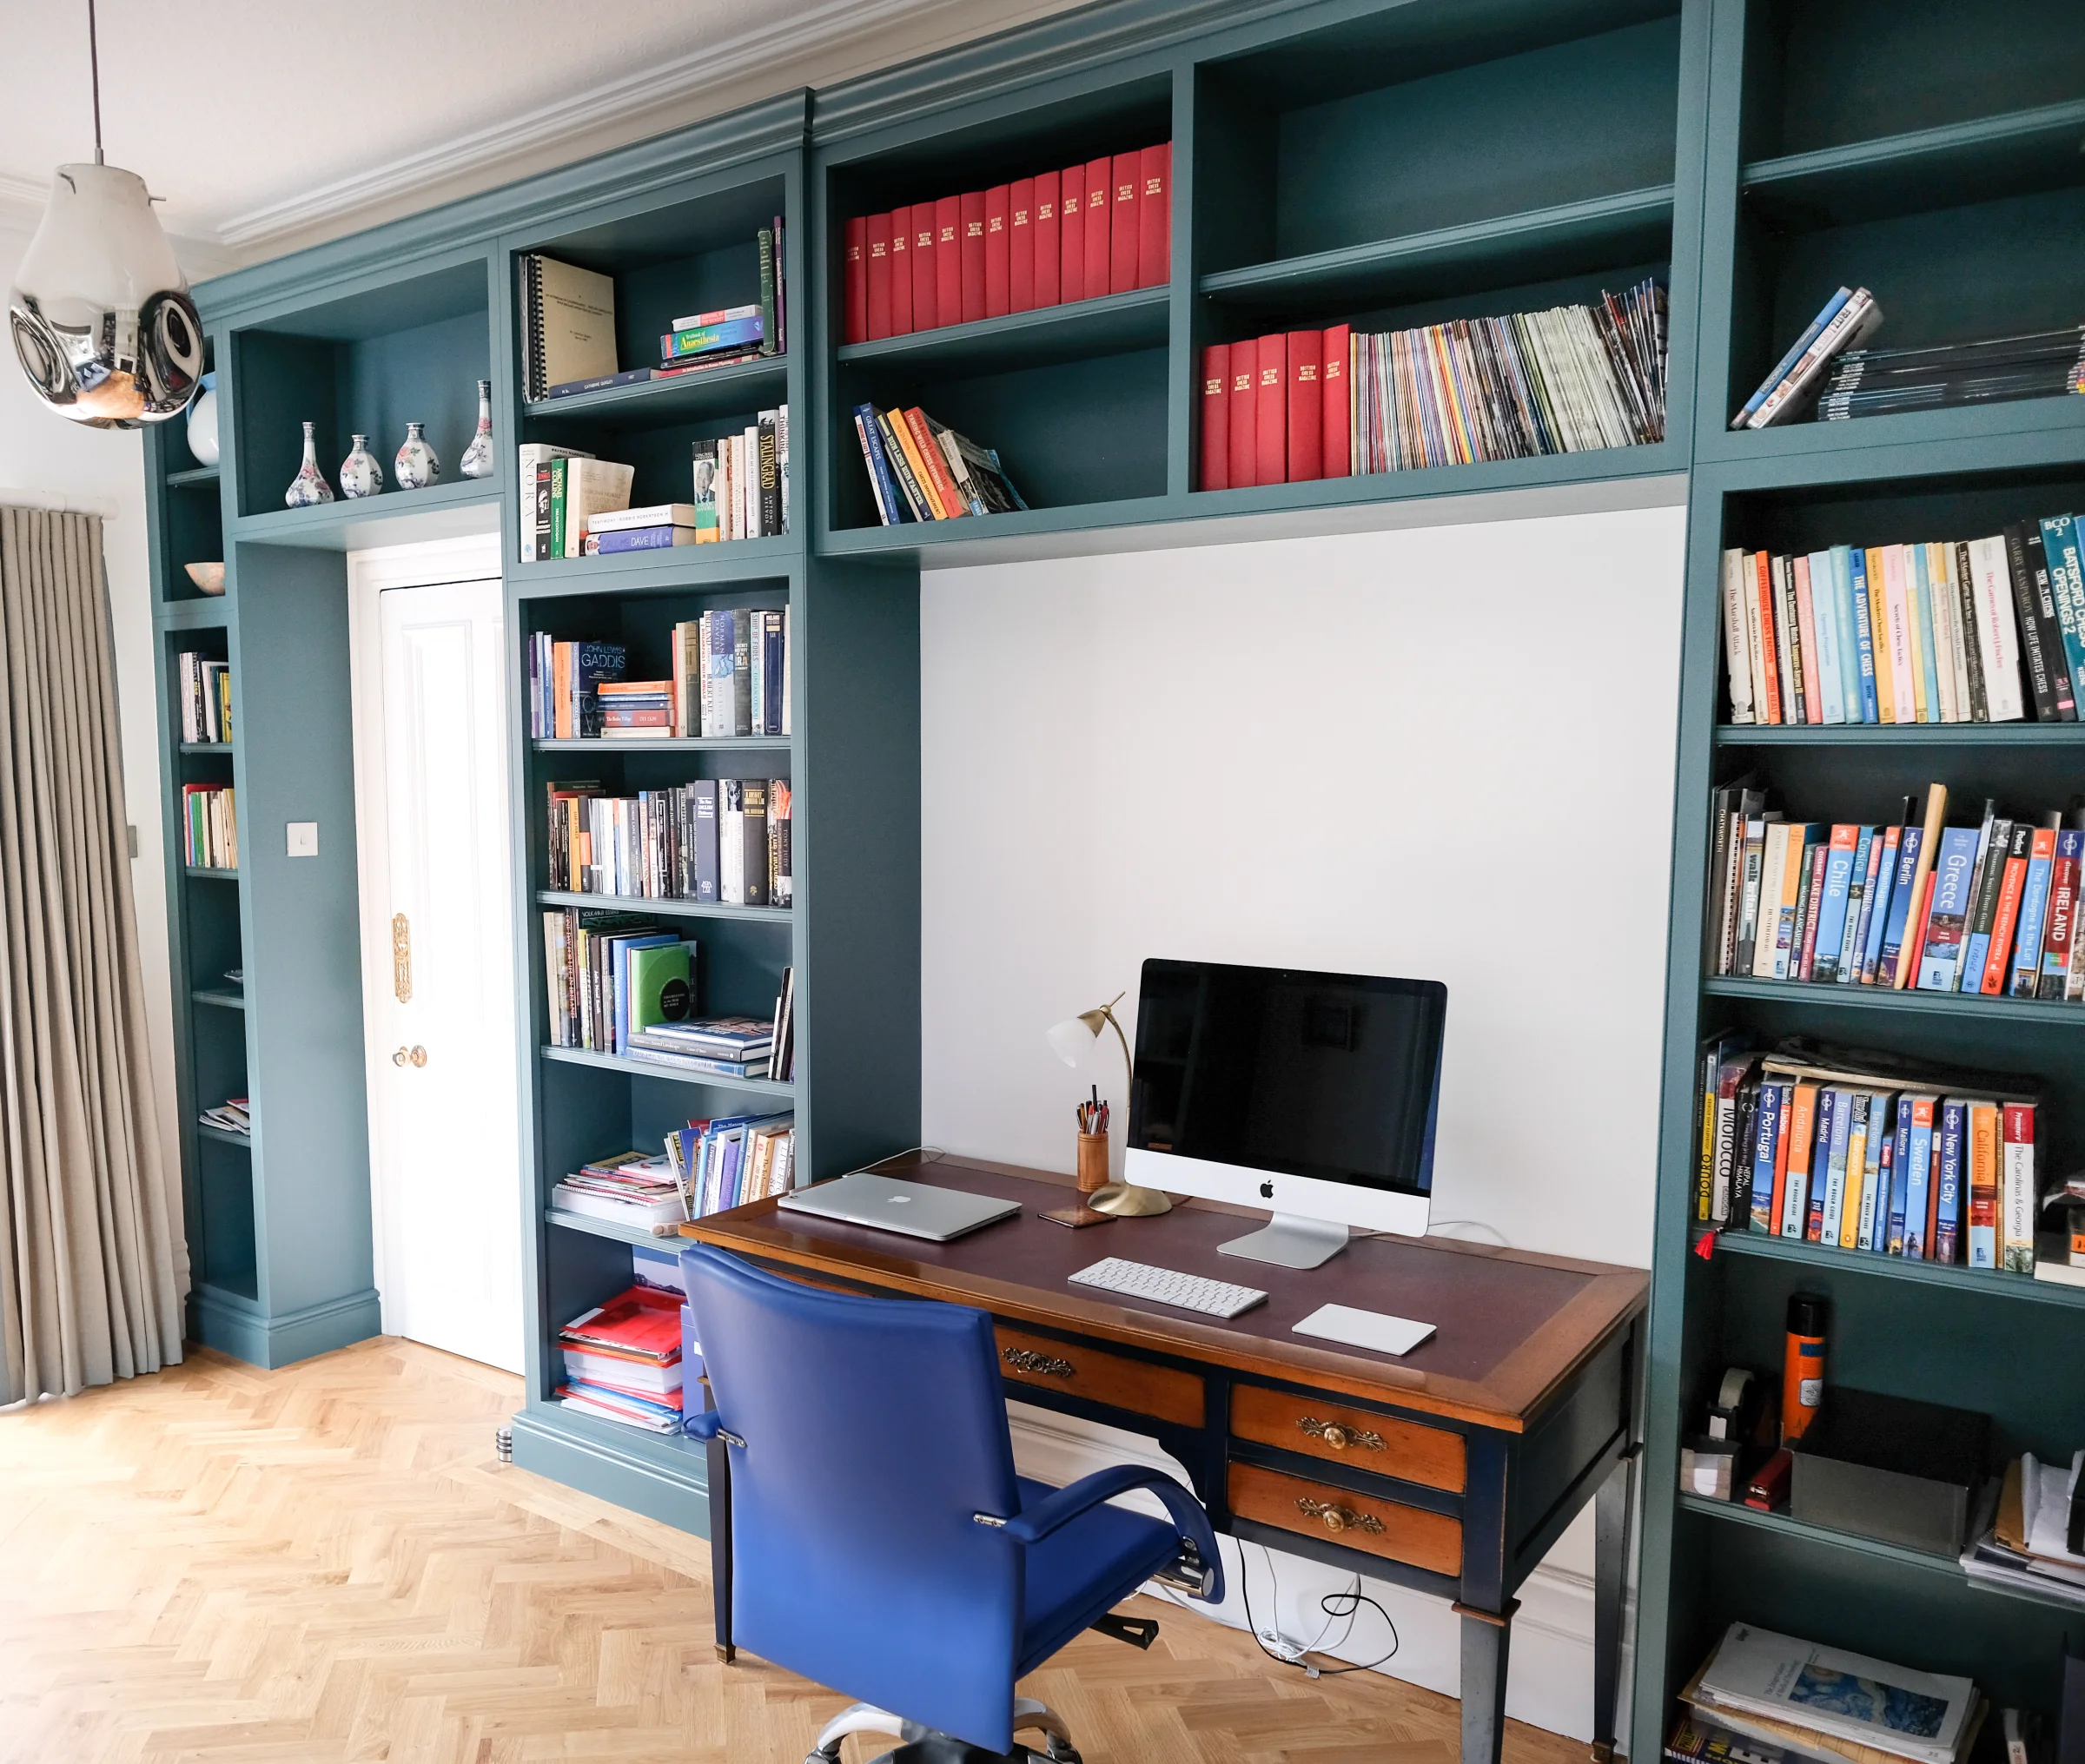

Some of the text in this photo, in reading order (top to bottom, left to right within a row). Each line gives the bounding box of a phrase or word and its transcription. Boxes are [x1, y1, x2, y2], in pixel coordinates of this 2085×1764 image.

[680, 334, 719, 348] Anaesthesia
[866, 415, 881, 459] GREAT ESCAPES
[907, 413, 945, 492] TAMING WILD CHESS OPENINGS
[760, 434, 775, 489] STALINGRAD
[886, 436, 924, 506] RUN LESS RUN FASTER
[525, 457, 534, 518] NORA
[917, 471, 941, 516] CHESS IMPROVEMENT
[631, 536, 649, 547] DAVE
[2044, 518, 2070, 530] BCO
[2055, 528, 2062, 537] 2
[1961, 561, 1969, 580] Master
[1787, 591, 1797, 626] The Centenary
[1986, 571, 2001, 640] The Games Robert
[2037, 569, 2055, 618] NEW CHESS
[2052, 568, 2075, 634] OPENINGS 2
[2062, 547, 2085, 648] BATSFORD CHESS
[1729, 588, 1742, 656] The Marshall Attack
[1758, 565, 1775, 664] COFFEEHOUSE CHESS TACTICS
[1854, 575, 1873, 677] THE ADVENTURE OF CHESS
[2010, 537, 2049, 694] GARRY KASPAROV HOW LIFE IMITATES CHESS
[581, 653, 626, 668] GADDIS
[585, 644, 602, 653] JOHN
[1768, 675, 1779, 716] JOHN HEALY
[1716, 809, 1726, 853] CHATSWORTH
[1855, 836, 1870, 872] Corsica
[1899, 856, 1915, 885] Berlin
[2062, 861, 2072, 884] discover
[1829, 860, 1849, 898] Chile
[1876, 861, 1893, 908] Copenhagen
[1939, 854, 1968, 909] Greece
[2006, 862, 2019, 895] PROVENCE
[2034, 867, 2045, 882] The
[1806, 878, 1821, 930] LAKE DISTRICT
[1862, 877, 1875, 912] CYPRUS
[2028, 884, 2042, 922] Dordogne
[2052, 886, 2071, 941] IRELAND
[1794, 884, 1808, 949] WALKING LANCASHIRE
[1998, 913, 2009, 937] FRENCH
[1969, 942, 1982, 972] France
[1994, 938, 2004, 961] RIVIERA
[2023, 948, 2033, 961] Lot
[2025, 933, 2035, 946] the
[1757, 1111, 1776, 1163] Portugal
[1779, 1109, 1789, 1134] Lisbon
[1794, 1105, 1808, 1153] Andalucia
[1819, 1117, 1830, 1143] Madrid
[1834, 1101, 1847, 1146] Barcelona
[1870, 1111, 1882, 1148] Barcelona
[1850, 1140, 1862, 1176] Barcelona
[1898, 1127, 1908, 1156] Mallorca
[1974, 1129, 1990, 1182] California
[2014, 1146, 2024, 1160] The
[1698, 1154, 1712, 1198] DOURO
[1910, 1138, 1928, 1186] Sweden
[1941, 1133, 1958, 1205] New York City
[2012, 1161, 2025, 1197] Carolinas
[1734, 1165, 1744, 1199] HIMALAYA
[2012, 1206, 2025, 1237] Georgia
